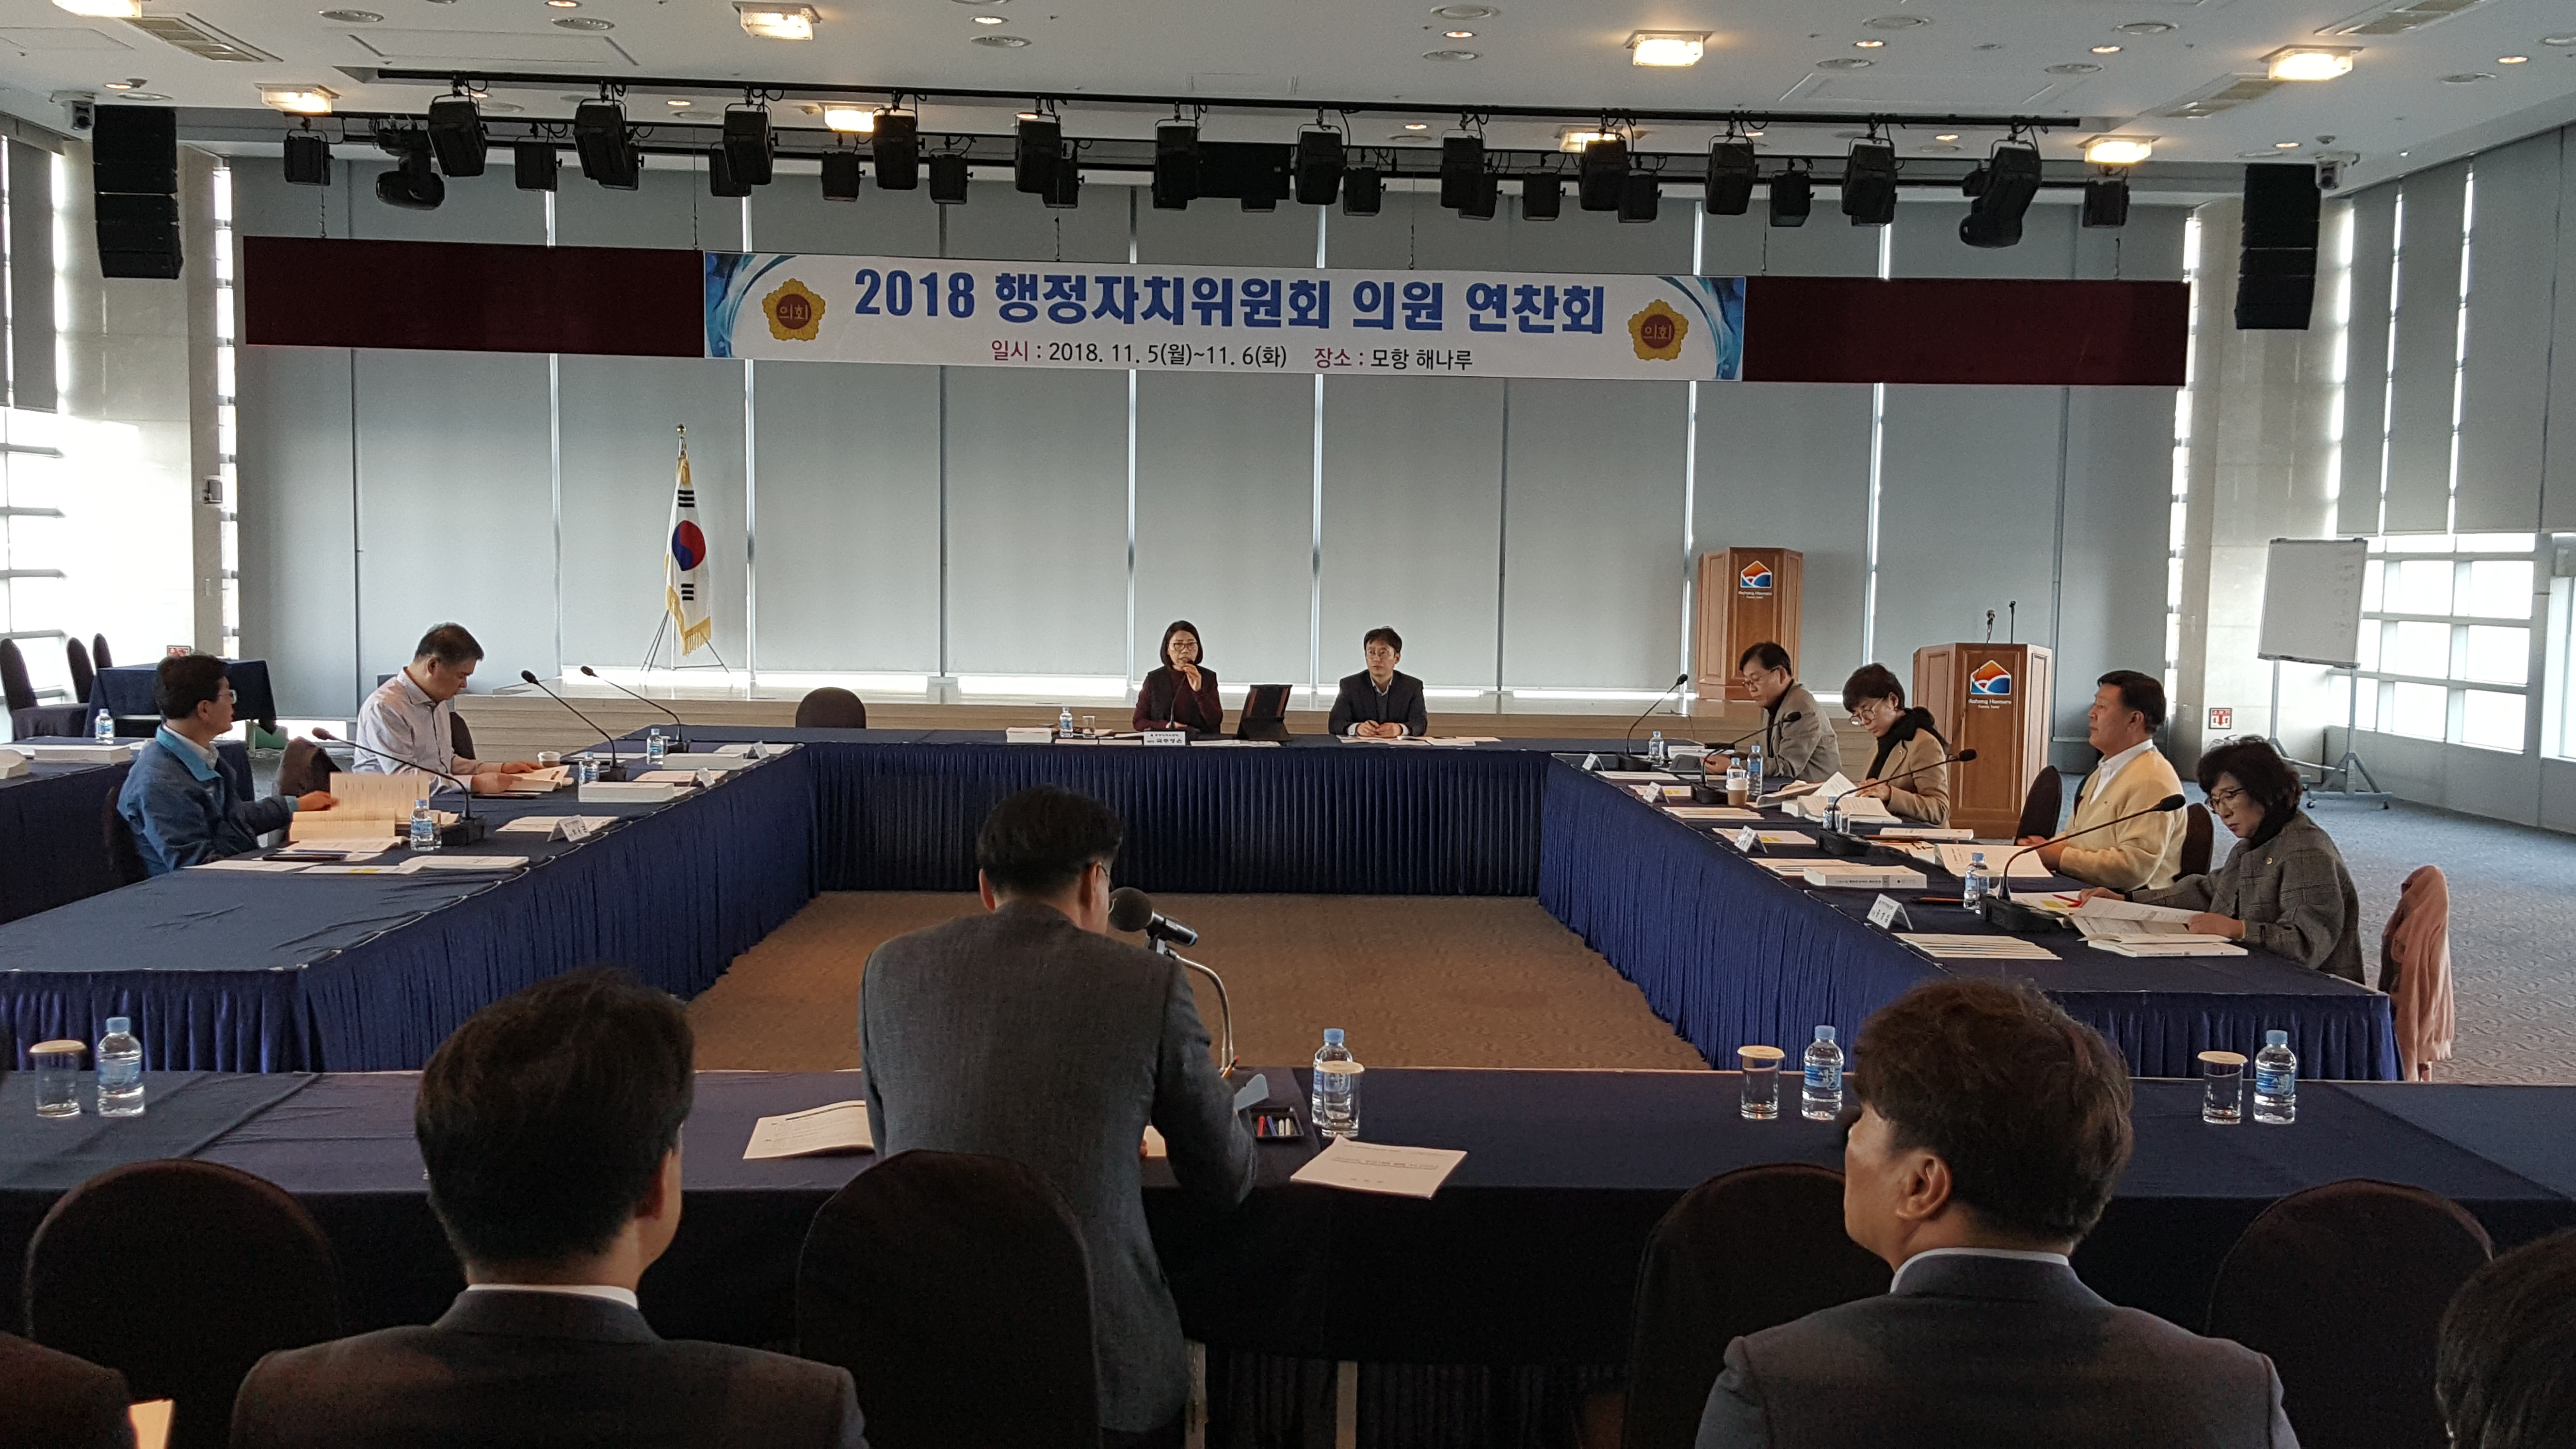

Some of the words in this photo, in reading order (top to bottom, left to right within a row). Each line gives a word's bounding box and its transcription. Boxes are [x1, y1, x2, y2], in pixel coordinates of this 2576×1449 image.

[778, 304, 807, 320] 의회
[855, 269, 975, 318] 2018
[996, 273, 1330, 329] 행정자치위원회
[1352, 281, 1443, 331] 의원
[1466, 282, 1604, 335] 연찬회
[1643, 323, 1671, 339] 의회
[991, 340, 1029, 362] 일시
[1049, 342, 1104, 363] 2018.
[1111, 343, 1140, 363] 11.
[1242, 345, 1287, 368] 6(화)
[1315, 347, 1352, 369] 장소
[1370, 348, 1410, 370] 모항
[1416, 349, 1473, 371] 해나루
